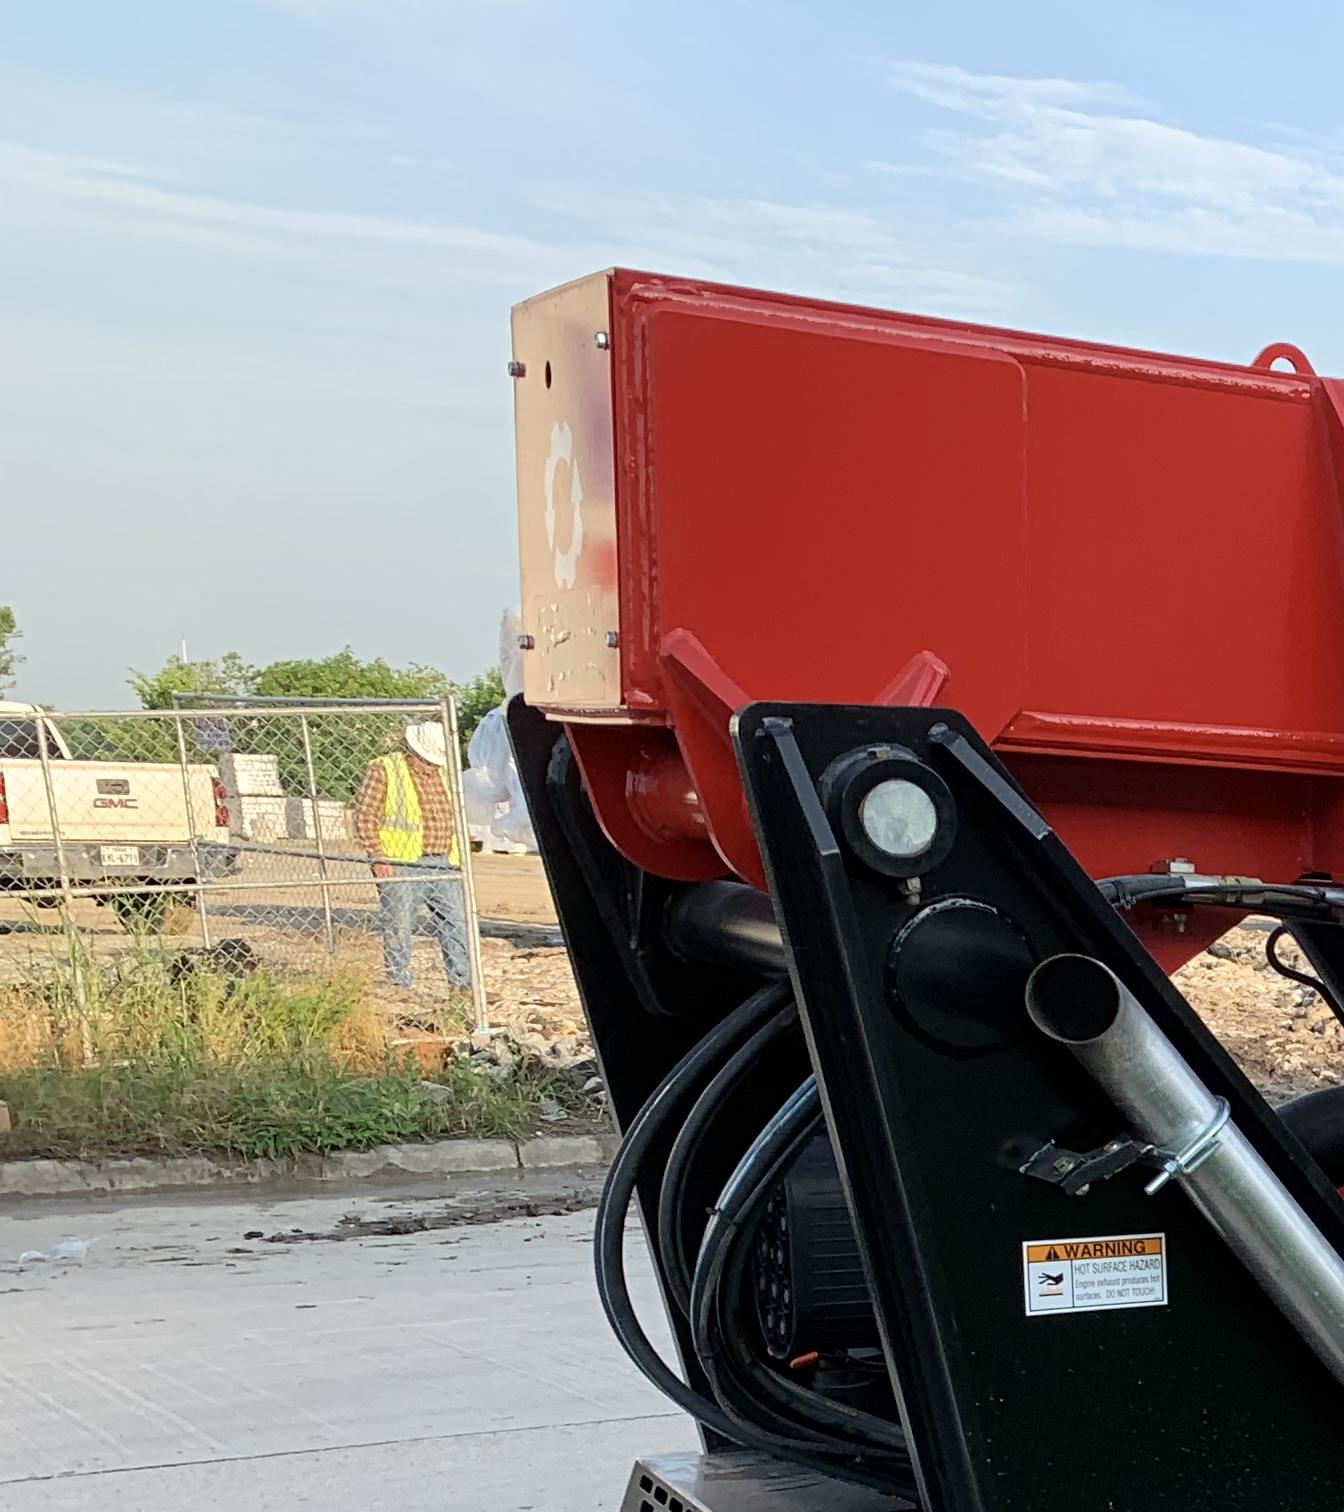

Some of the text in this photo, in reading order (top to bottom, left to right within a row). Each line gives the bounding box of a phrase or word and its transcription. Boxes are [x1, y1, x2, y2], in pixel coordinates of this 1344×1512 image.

[93, 798, 138, 809] GMC
[1064, 1241, 1146, 1258] WARNING
[1074, 1258, 1161, 1275] HOT SURFACE HAZARD
[1106, 1289, 1115, 1299] DO
[1116, 1288, 1130, 1298] NOT
